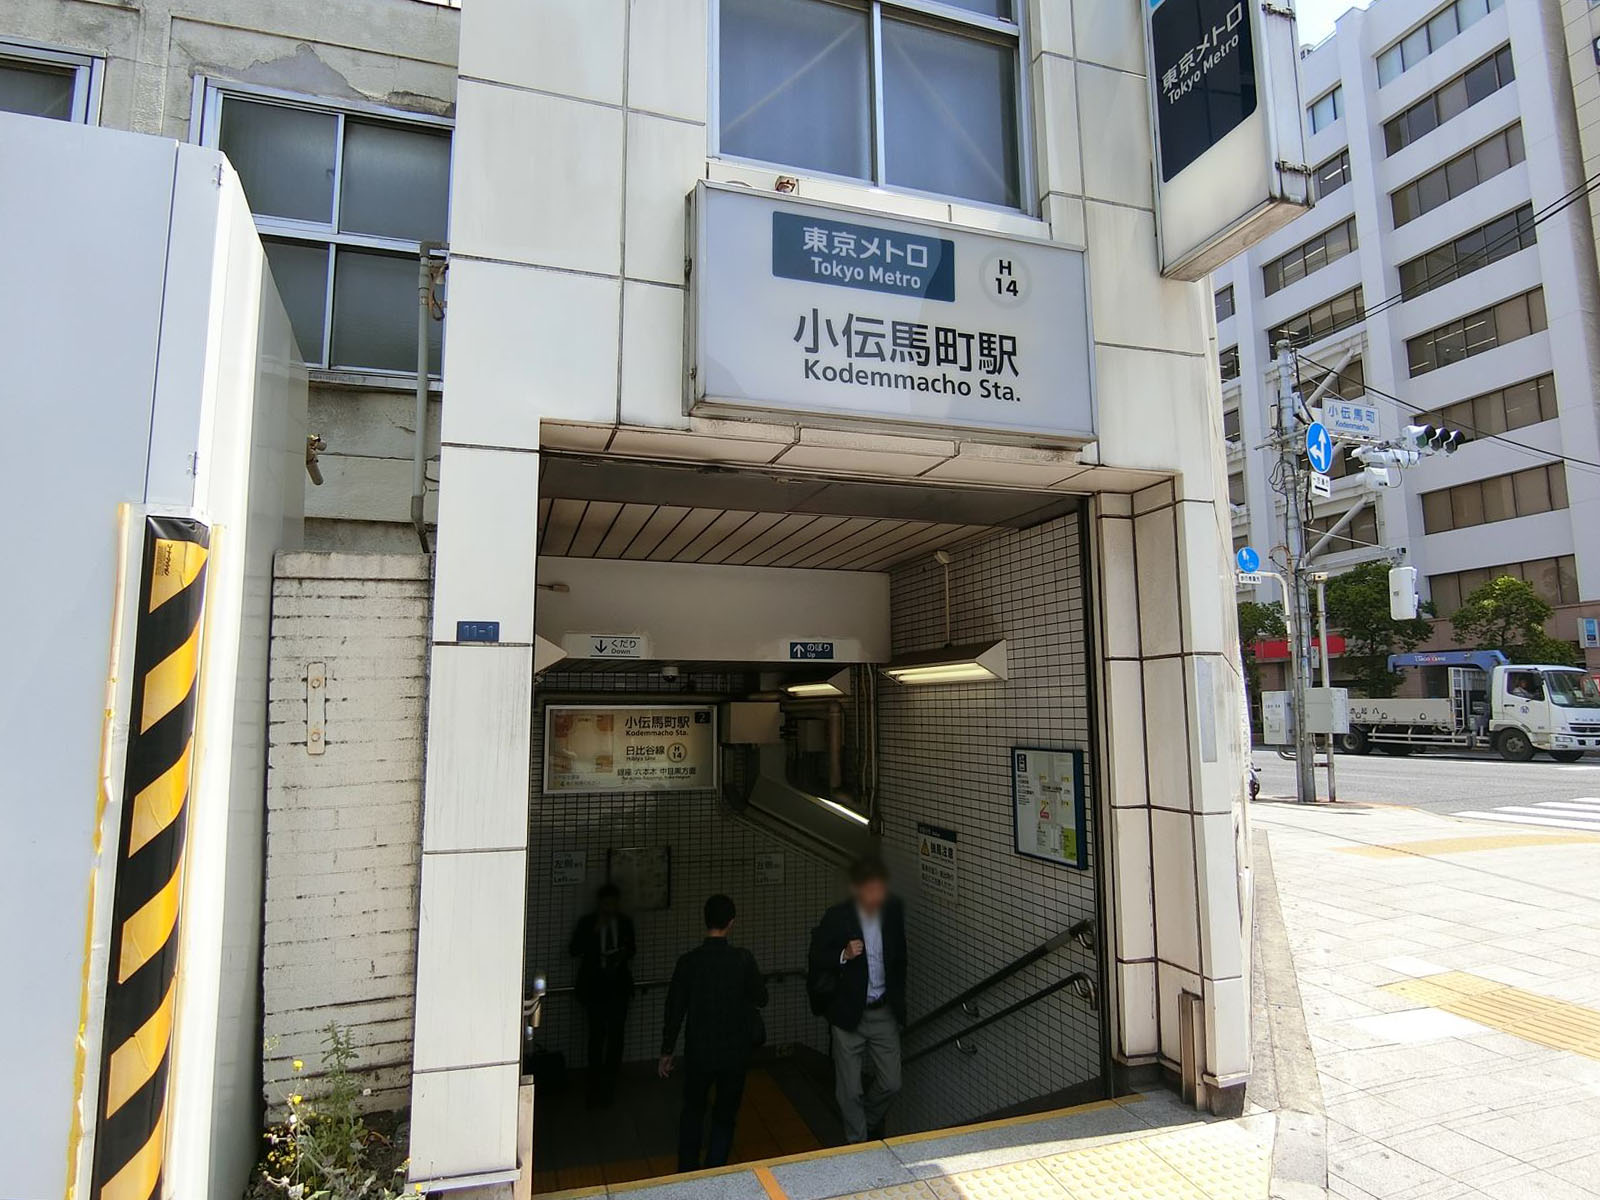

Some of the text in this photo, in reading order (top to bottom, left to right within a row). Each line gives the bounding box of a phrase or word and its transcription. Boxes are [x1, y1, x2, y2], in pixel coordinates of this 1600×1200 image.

[1162, 2, 1242, 94] 東京メトロ
[1168, 34, 1239, 104] Tokyo Metro
[802, 226, 929, 268] 東京メトロ
[811, 257, 921, 290] Tokyo Metro
[999, 259, 1012, 277] H
[994, 277, 1019, 298] 14
[793, 307, 1020, 379] 小伝馬町駅
[803, 358, 1021, 403] Kodemmacho Sta.
[1328, 405, 1375, 424] 小伝馬町
[611, 639, 637, 649] くだり
[807, 643, 830, 652] のぼり
[624, 715, 690, 729] 小伝馬町駅
[625, 729, 674, 737] Kodemmacho
[626, 745, 665, 756] 日比谷線
[672, 751, 683, 760] 14
